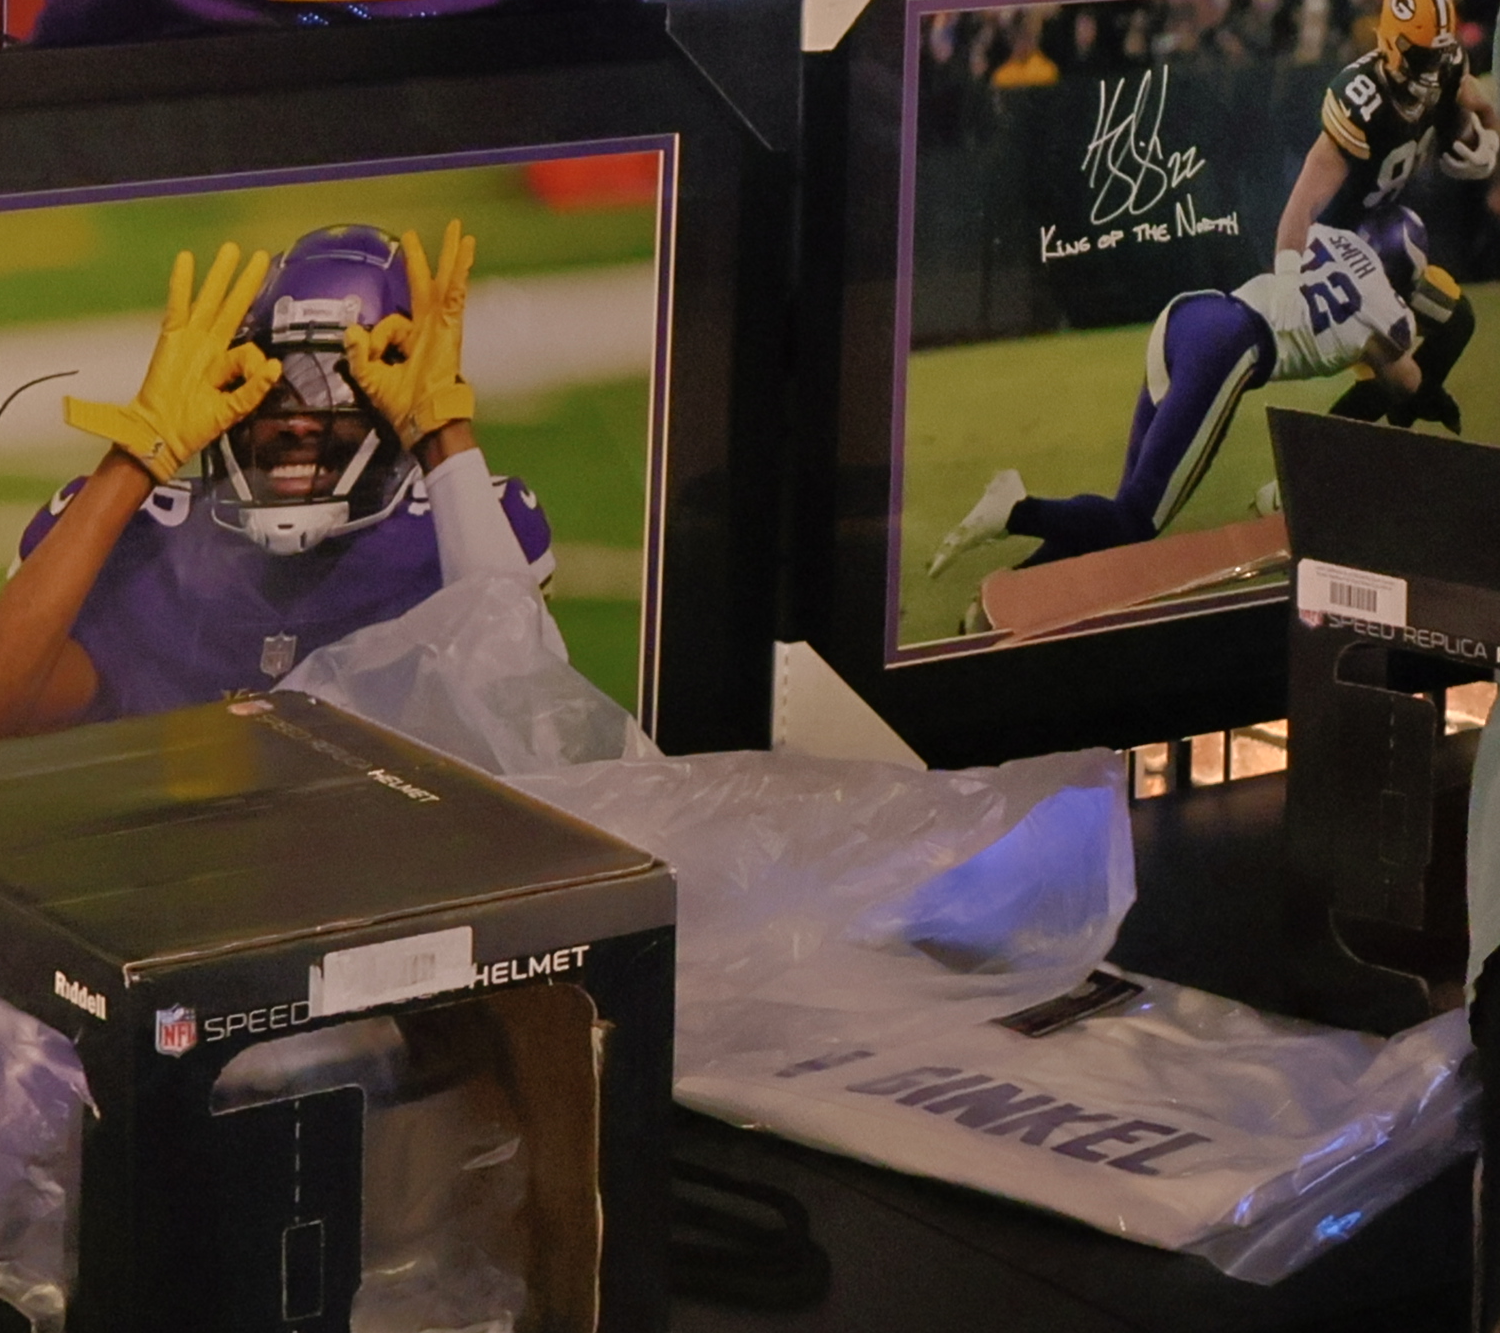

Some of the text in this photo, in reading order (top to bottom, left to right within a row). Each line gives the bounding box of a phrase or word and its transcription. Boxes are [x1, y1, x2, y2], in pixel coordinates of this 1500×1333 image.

[1329, 235, 1376, 280] SMITH
[1402, 625, 1488, 660] REPLICA
[54, 969, 107, 1022] Riddell
[204, 999, 312, 1043] SPEED
[470, 944, 591, 990] HELMET
[846, 1065, 1213, 1177] GINKEL
